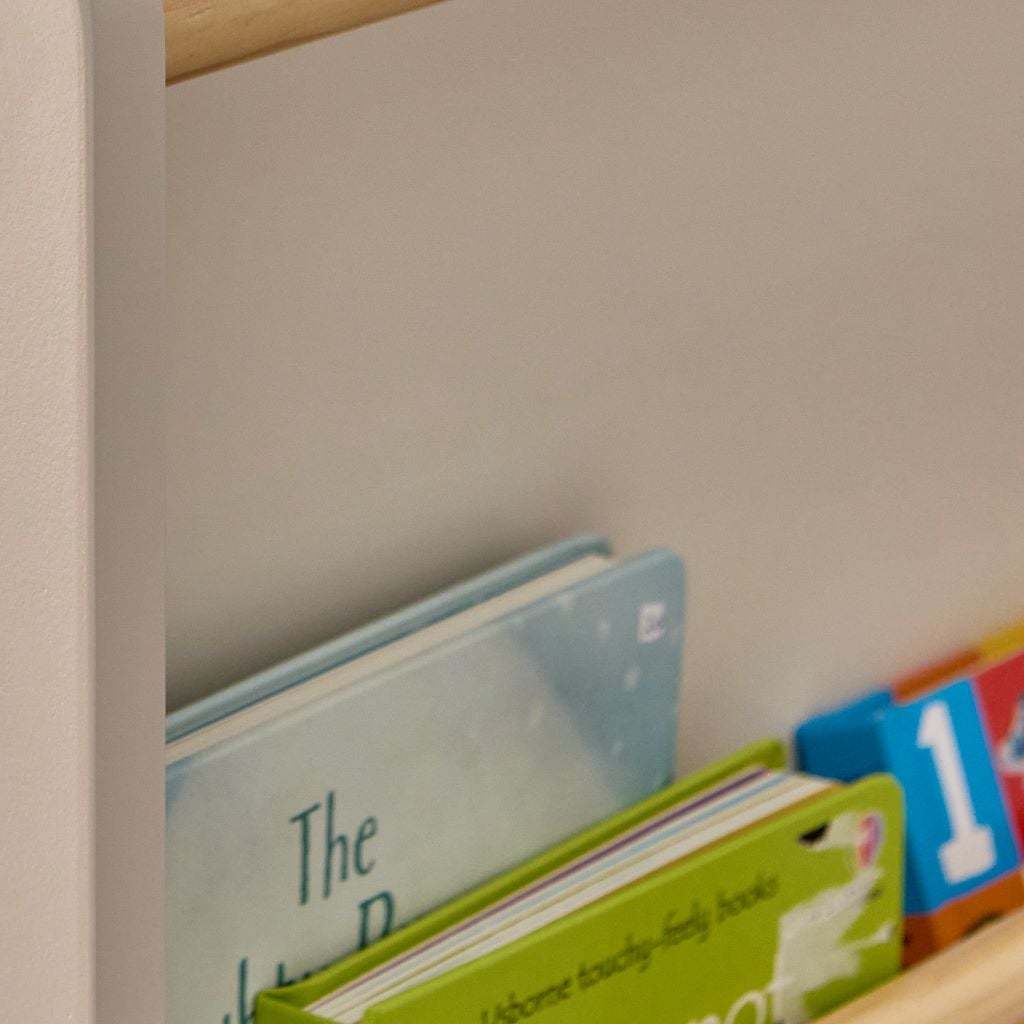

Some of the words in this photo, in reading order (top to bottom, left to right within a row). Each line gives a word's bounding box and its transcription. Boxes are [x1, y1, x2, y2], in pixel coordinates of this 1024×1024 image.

[289, 788, 379, 906] The
[916, 699, 998, 885] 1
[577, 898, 713, 991] touchy-feely
[715, 870, 780, 924] books
